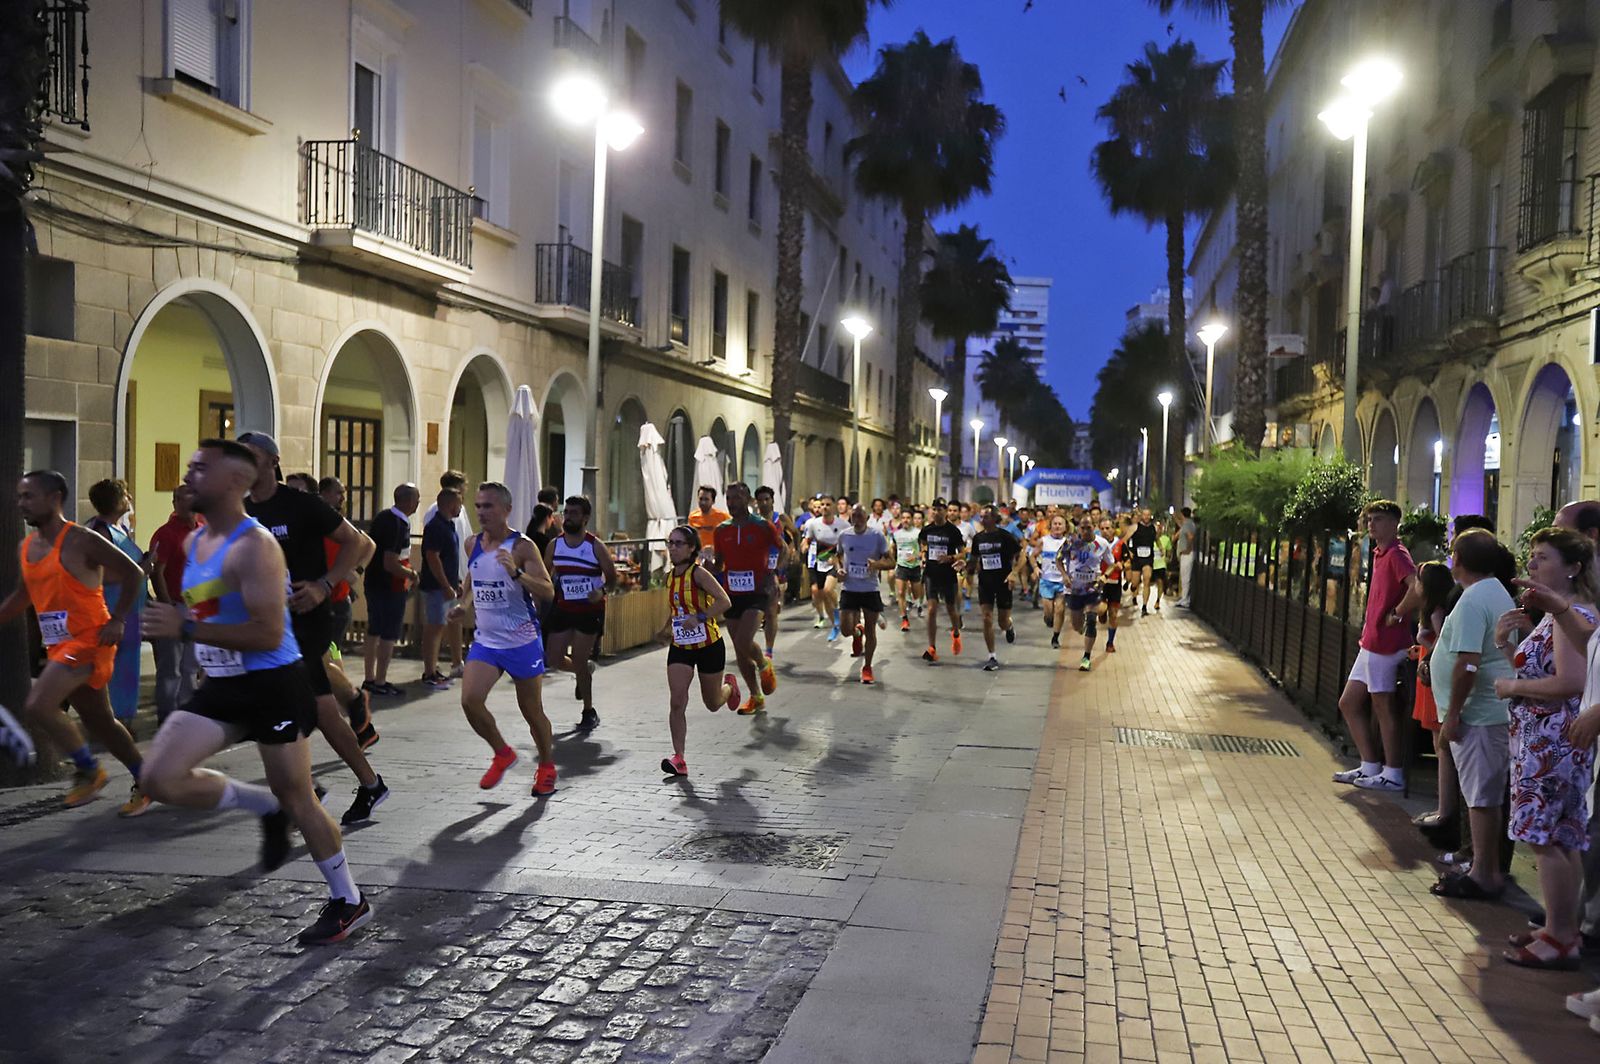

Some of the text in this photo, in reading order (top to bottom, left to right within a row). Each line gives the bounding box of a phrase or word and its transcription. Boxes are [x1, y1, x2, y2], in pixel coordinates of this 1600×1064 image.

[1039, 486, 1085, 497] Huelva
[570, 585, 584, 594] 486
[481, 590, 496, 602] 269
